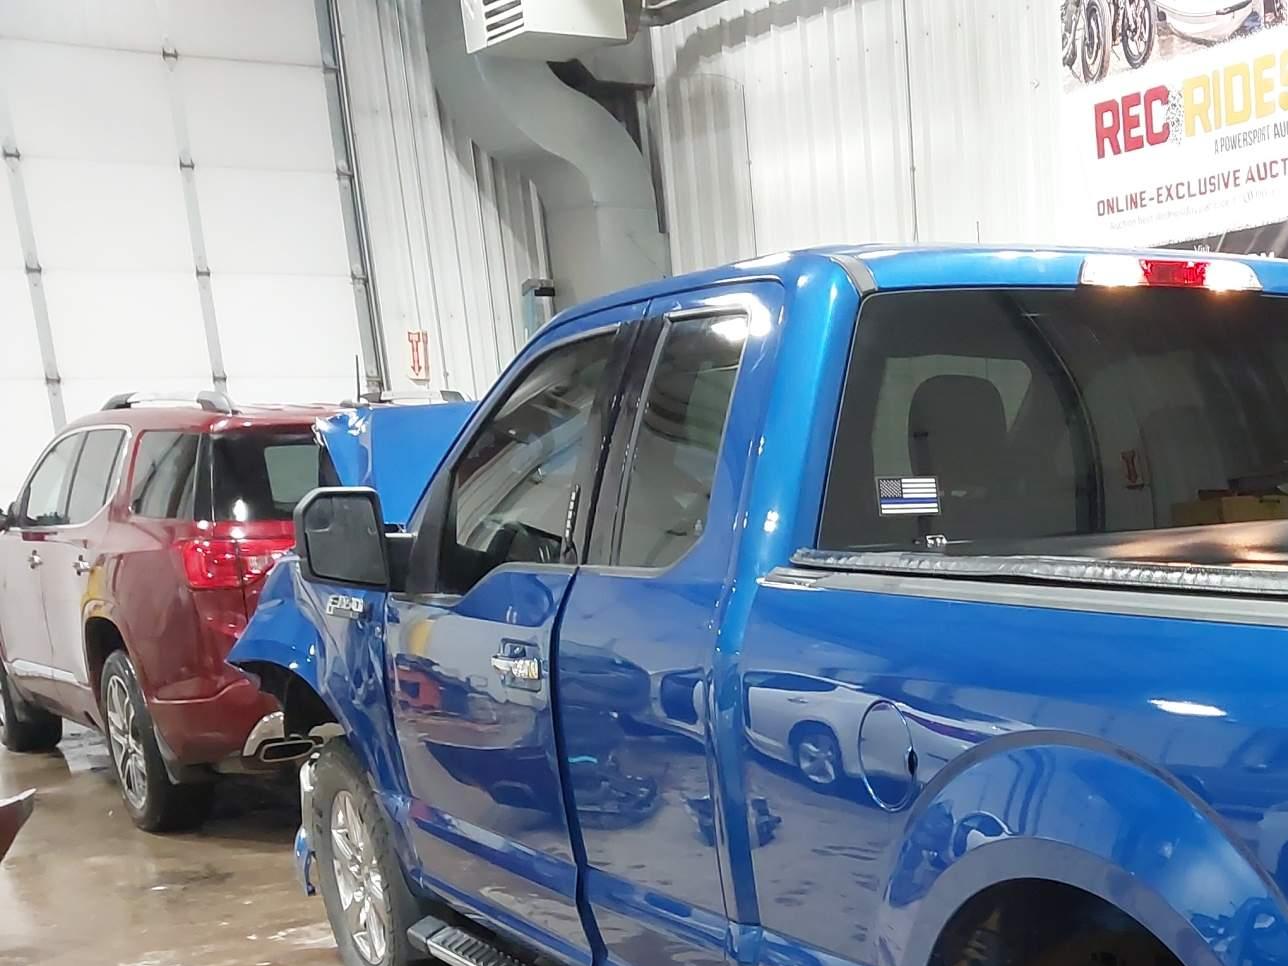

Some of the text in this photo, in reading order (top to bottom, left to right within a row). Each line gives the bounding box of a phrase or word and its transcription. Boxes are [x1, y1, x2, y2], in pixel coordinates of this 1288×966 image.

[1094, 85, 1170, 159] REC
[1220, 124, 1270, 152] POWERSPORT
[1097, 169, 1240, 216] ONLINE-EXCLUSIVE
